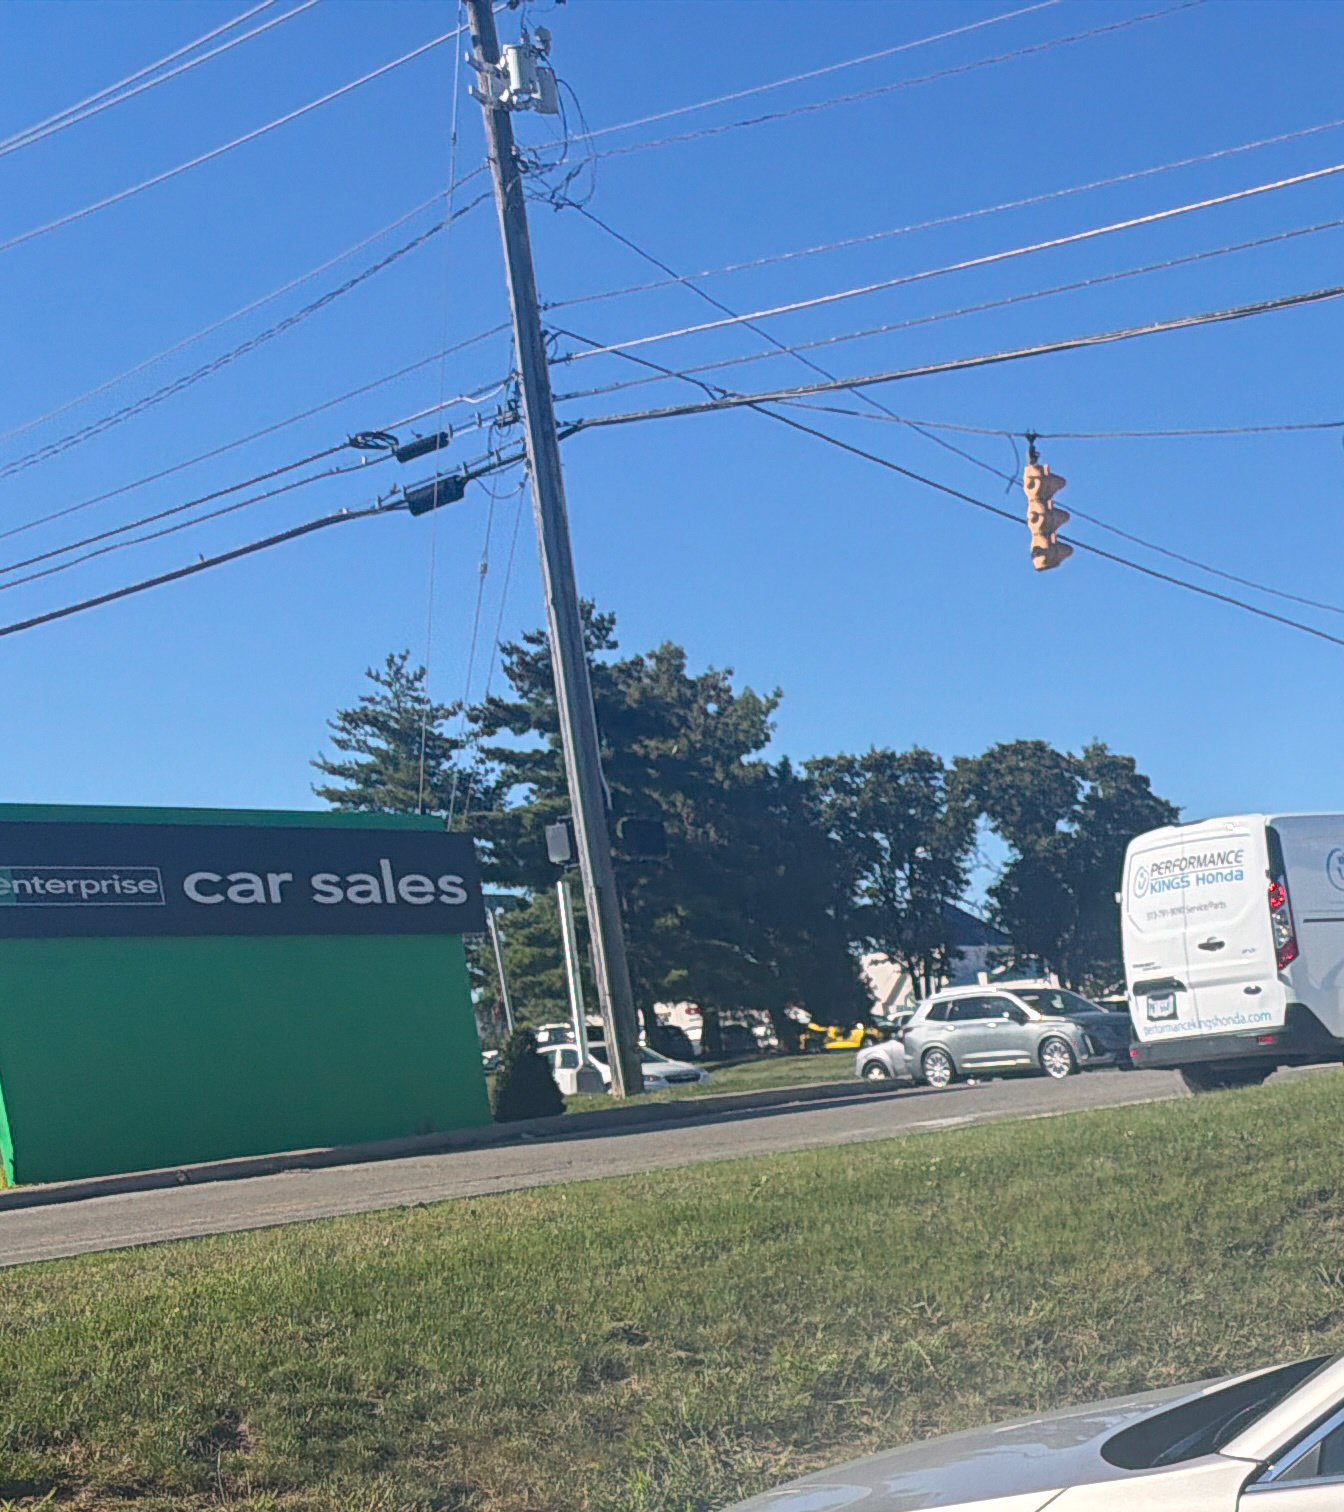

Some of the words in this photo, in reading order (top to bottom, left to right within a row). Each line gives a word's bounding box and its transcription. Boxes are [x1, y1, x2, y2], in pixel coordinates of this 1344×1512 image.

[1150, 850, 1244, 876] PERFORMANCE
[183, 871, 293, 904] car
[310, 858, 468, 904] sales
[1150, 874, 1190, 894] KINGS
[1196, 869, 1244, 886] Honda
